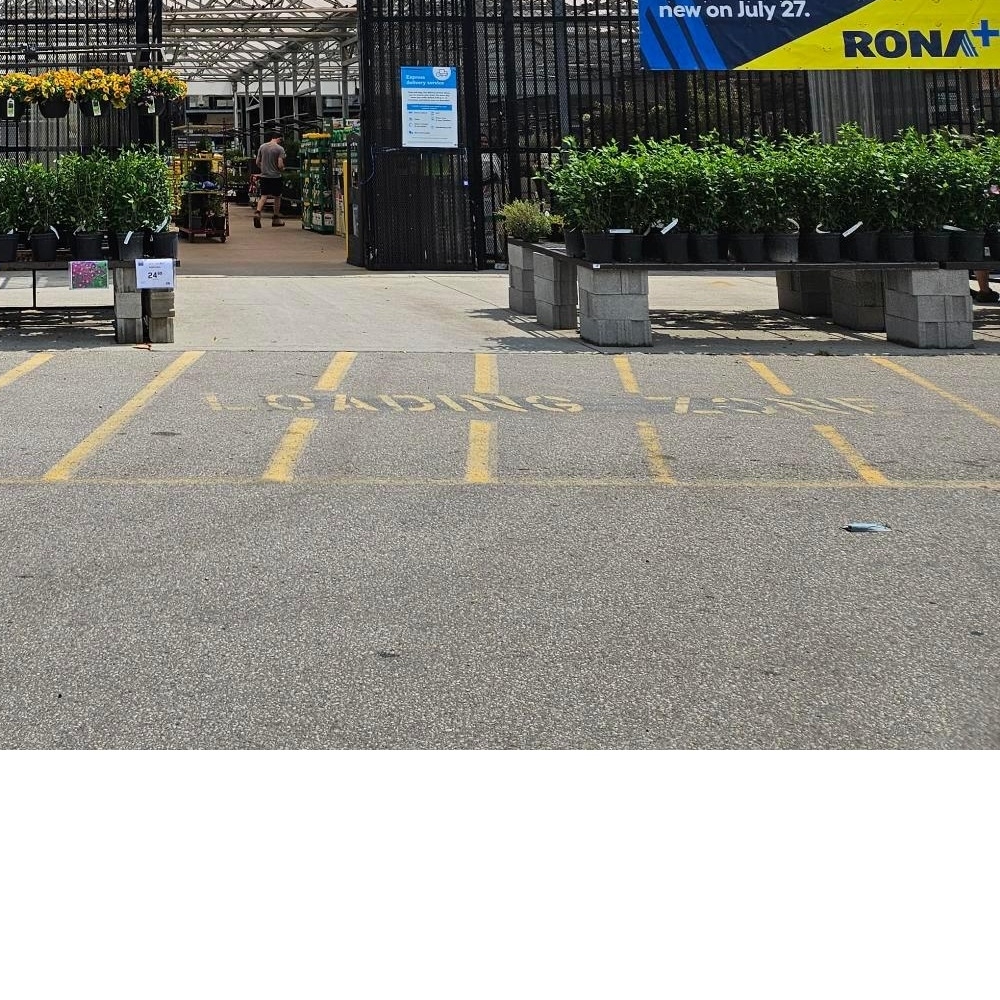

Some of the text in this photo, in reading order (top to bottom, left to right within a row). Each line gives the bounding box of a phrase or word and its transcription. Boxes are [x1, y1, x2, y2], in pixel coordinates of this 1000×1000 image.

[659, 0, 811, 21] new on July 27.
[203, 392, 584, 414] LOADING
